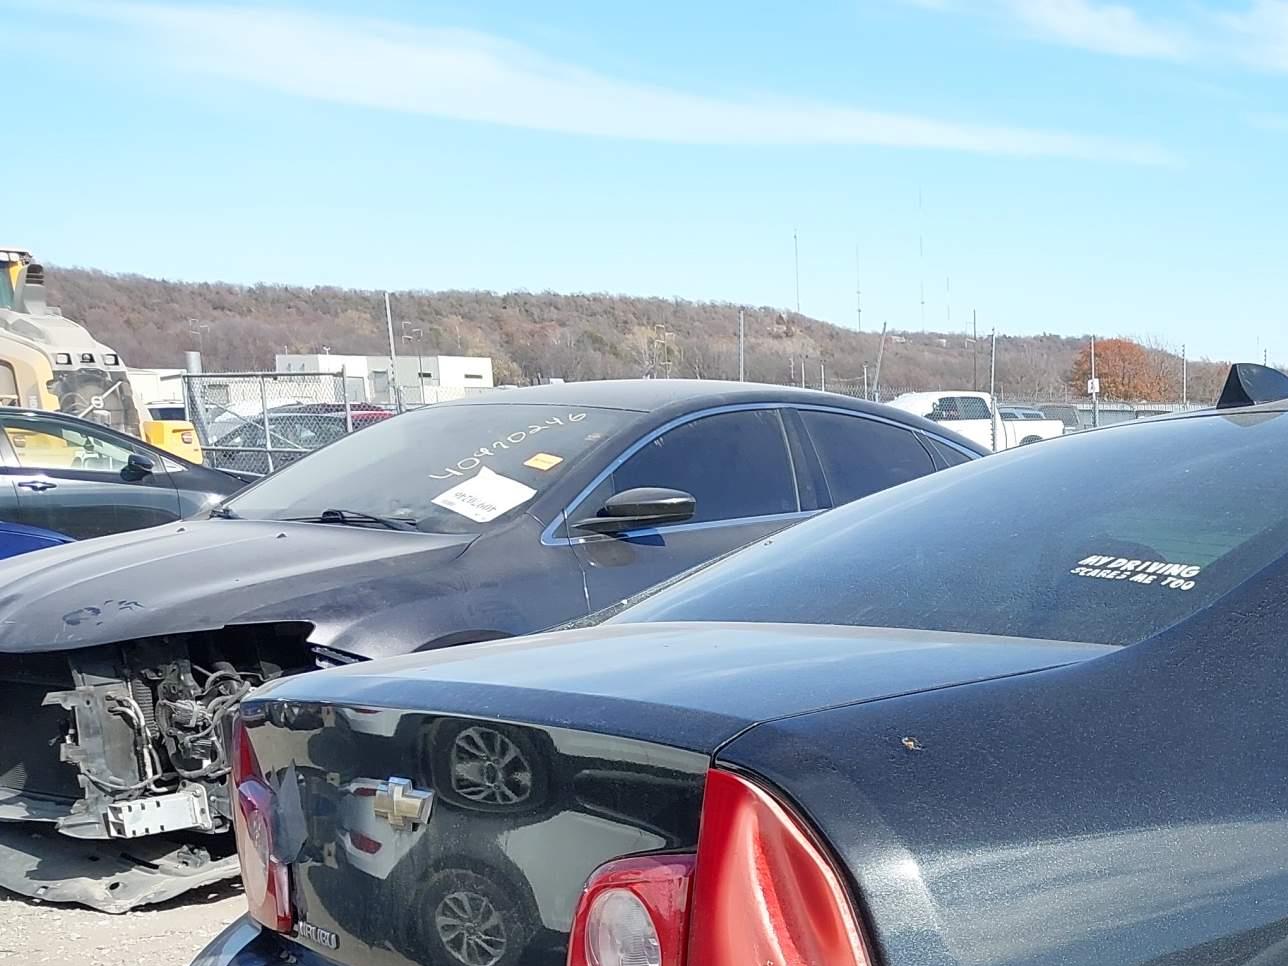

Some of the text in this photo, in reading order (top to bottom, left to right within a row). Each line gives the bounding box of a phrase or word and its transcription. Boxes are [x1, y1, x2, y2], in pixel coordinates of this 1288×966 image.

[1077, 554, 1201, 578] MY DRIVING
[1070, 566, 1196, 591] SCARES ME TOO
